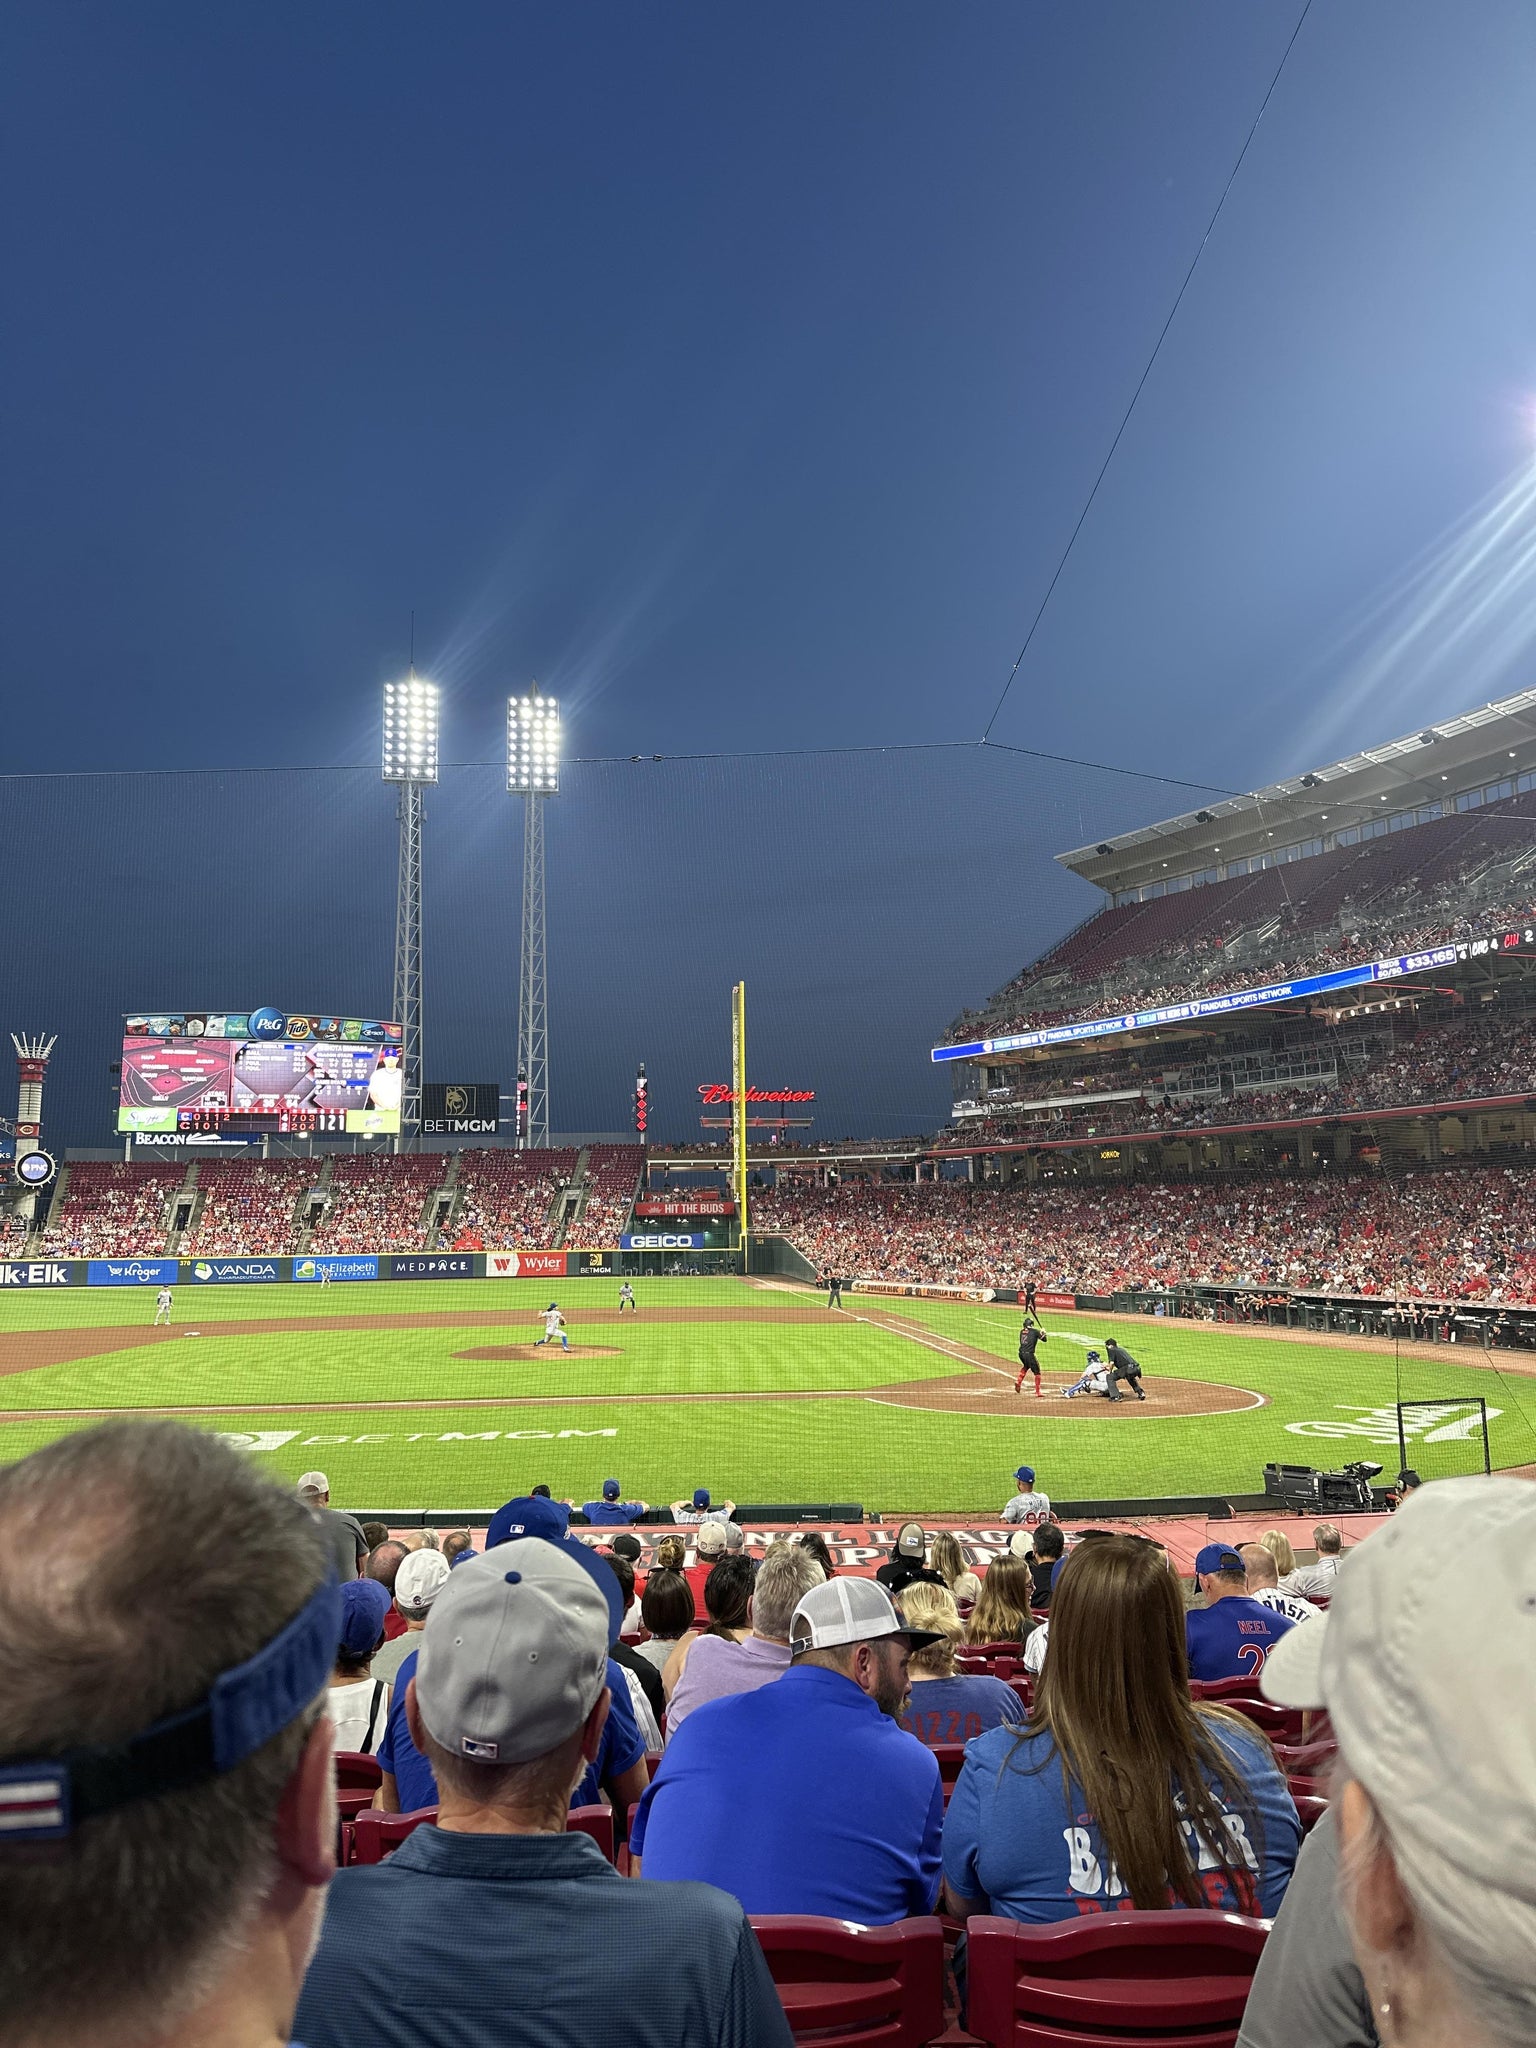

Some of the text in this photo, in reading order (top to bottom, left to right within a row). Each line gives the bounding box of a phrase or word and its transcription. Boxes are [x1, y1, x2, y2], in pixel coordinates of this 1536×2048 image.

[1504, 930, 1534, 948] CIN 2
[1472, 938, 1498, 956] CHC 4
[1406, 950, 1454, 969] $33,165
[1460, 951, 1467, 960] 4
[1201, 1000, 1232, 1012] FANDUEL
[1232, 995, 1258, 1006] SPORTS
[1258, 986, 1292, 1000] NETWORK
[257, 1018, 282, 1030] P&G
[288, 1022, 308, 1034] Tide
[1073, 1026, 1095, 1036] SPORTS
[1095, 1020, 1122, 1032] NETWORK
[698, 1084, 815, 1104] Budweiser
[328, 1115, 336, 1130] 2
[424, 1120, 496, 1132] BETMGM
[136, 1132, 186, 1145] BEACON
[665, 1203, 724, 1214] HIT THE BUDS
[630, 1235, 693, 1248] GEICO
[214, 1264, 276, 1275] VANDA
[330, 1262, 375, 1272] Elizabeth
[396, 1260, 468, 1271] MEDPACE
[524, 1257, 562, 1271] Wyler
[125, 1262, 160, 1282] Kroger
[300, 1428, 619, 1445] BETMGM
[1238, 1620, 1271, 1634] NEEL
